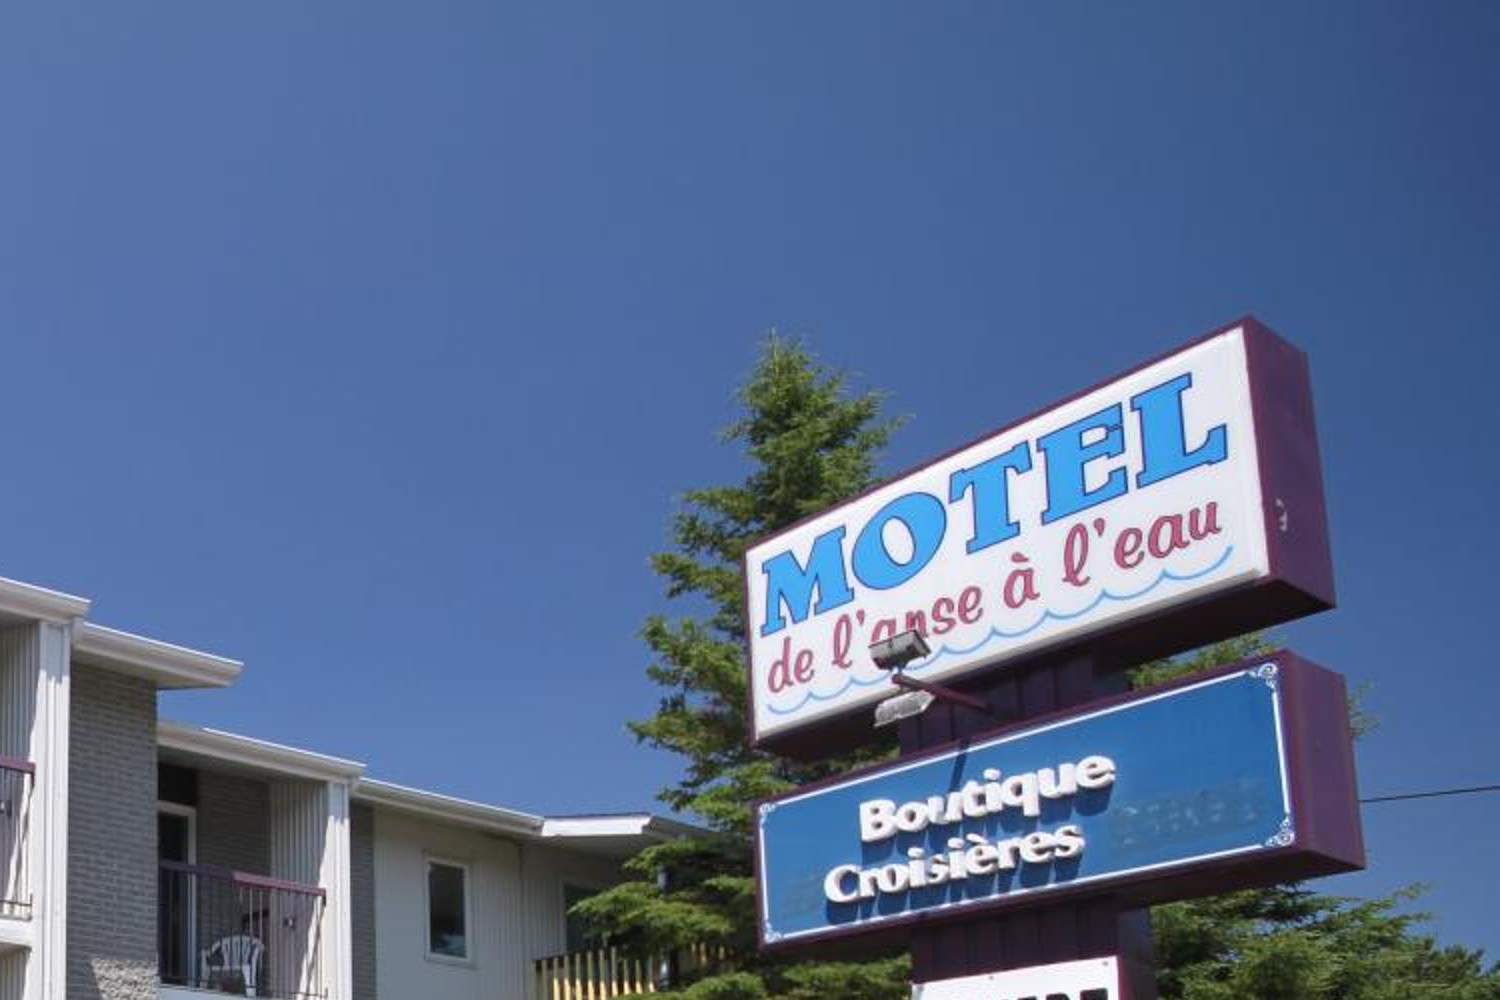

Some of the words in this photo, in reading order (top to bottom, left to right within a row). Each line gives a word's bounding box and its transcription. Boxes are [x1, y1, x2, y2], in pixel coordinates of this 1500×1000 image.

[760, 372, 1227, 636] MOTEL
[767, 635, 815, 693] de
[1003, 552, 1041, 610] à
[1062, 501, 1221, 588] l'eau
[824, 823, 1085, 904] Croisières
[859, 755, 1116, 843] Boutique
